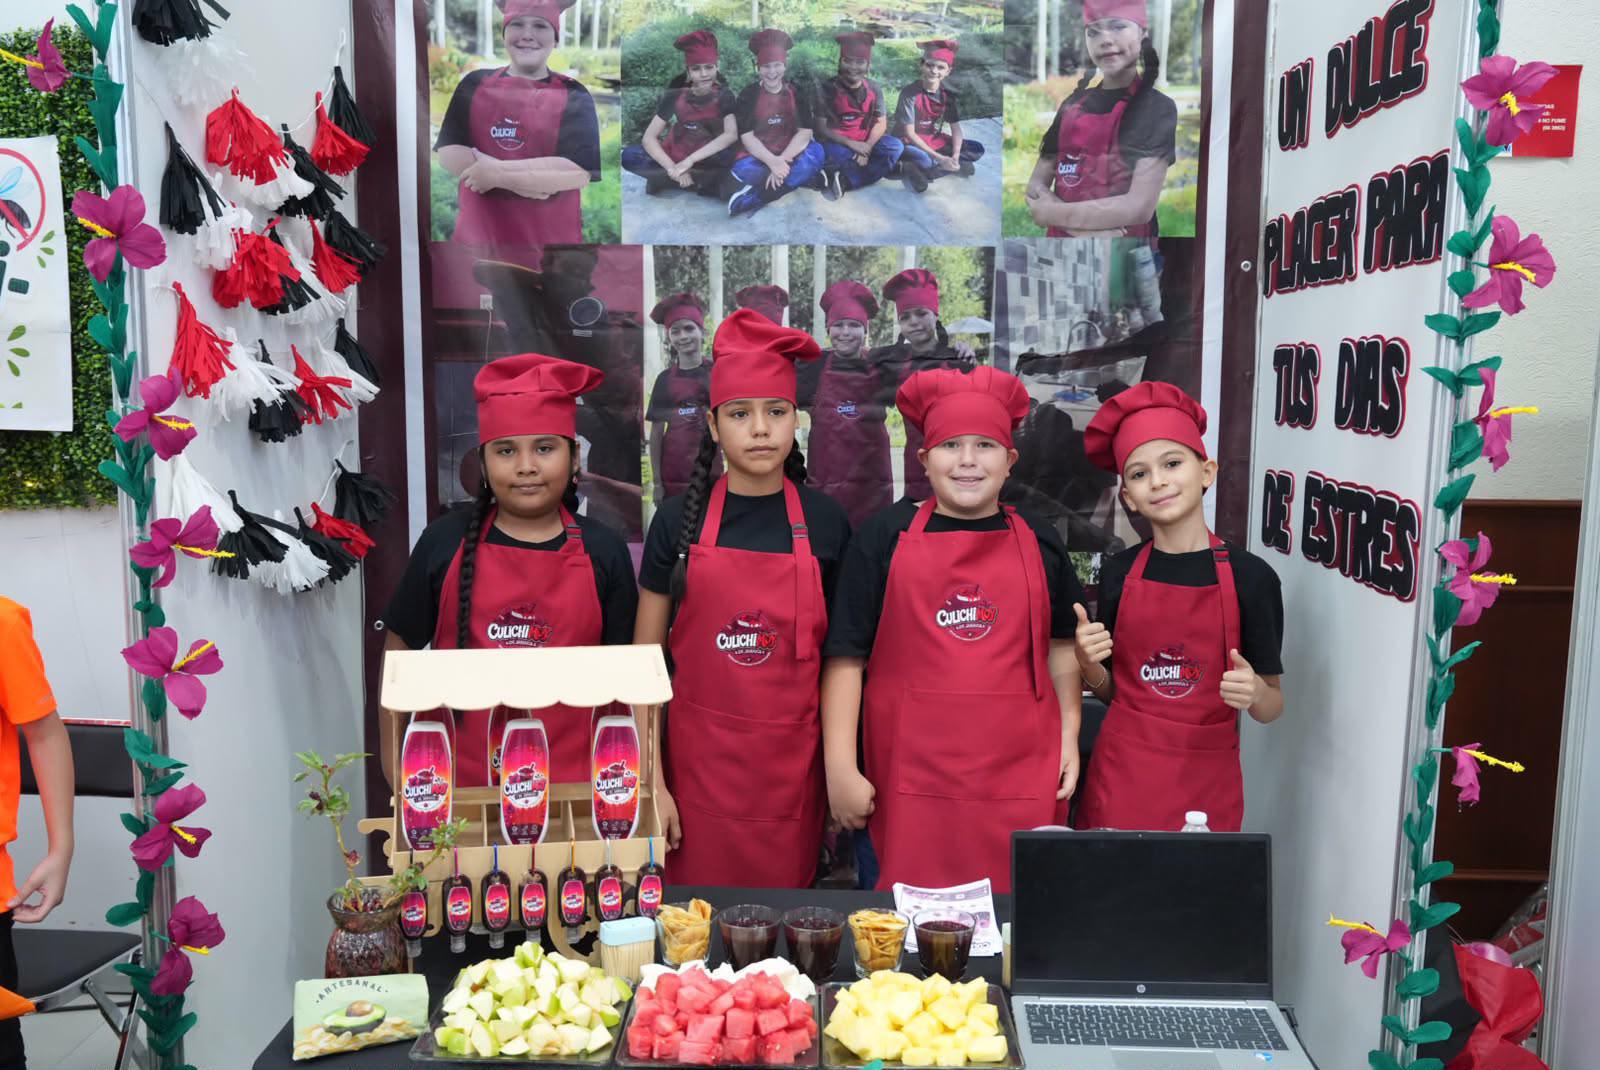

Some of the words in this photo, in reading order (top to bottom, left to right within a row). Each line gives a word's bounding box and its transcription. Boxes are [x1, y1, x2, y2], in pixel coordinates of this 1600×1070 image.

[1278, 57, 1314, 151] UN
[1325, 0, 1436, 138] DULCE
[1263, 184, 1361, 298] PLACER
[1363, 148, 1450, 274] PARA
[1273, 342, 1321, 430] TUS
[1334, 335, 1411, 438] DIAS
[1261, 469, 1295, 555] DE
[1301, 471, 1422, 603] ESTRES
[318, 979, 385, 1001] ARTESANAL
